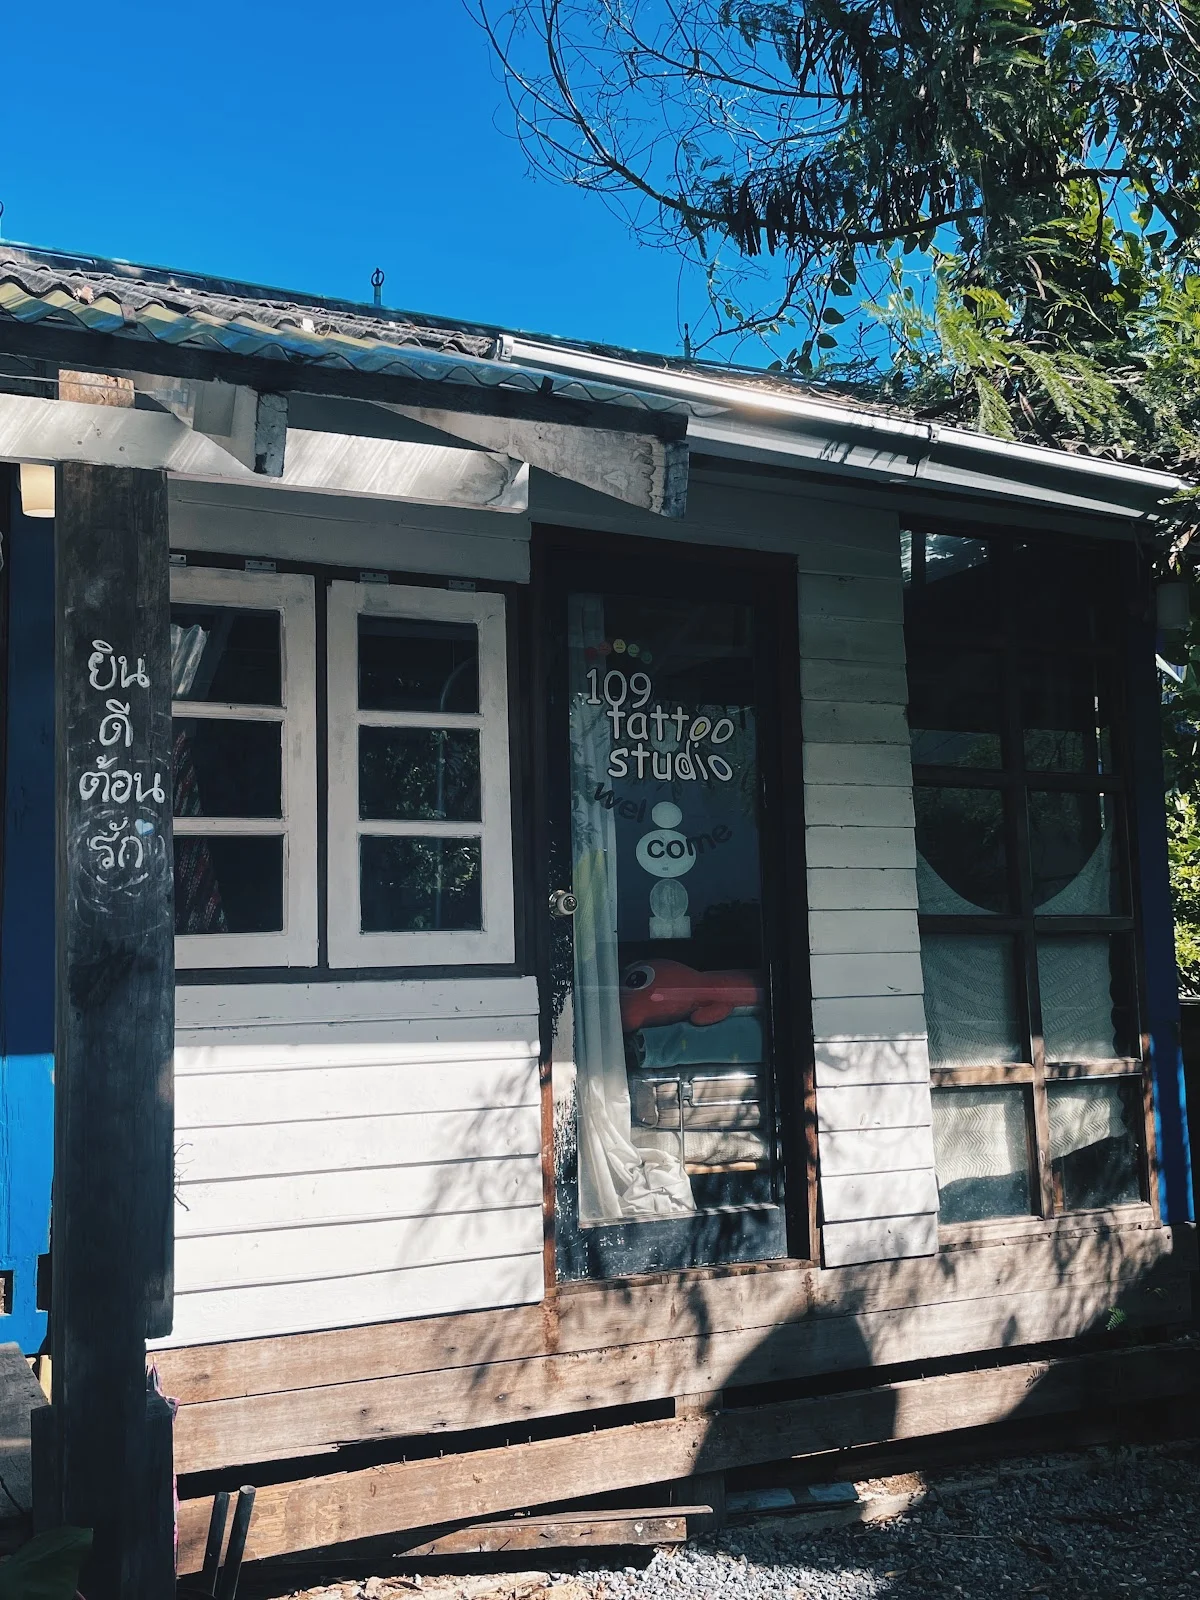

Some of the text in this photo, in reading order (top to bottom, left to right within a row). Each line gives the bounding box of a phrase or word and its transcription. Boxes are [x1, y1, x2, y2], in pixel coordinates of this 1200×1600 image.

[88, 639, 150, 691] ยิน
[586, 668, 652, 709] 109
[99, 698, 134, 748] ดี
[606, 704, 735, 744] tattoo
[79, 755, 166, 804] ต้อน
[607, 739, 734, 782] studio
[90, 816, 144, 869] รัก
